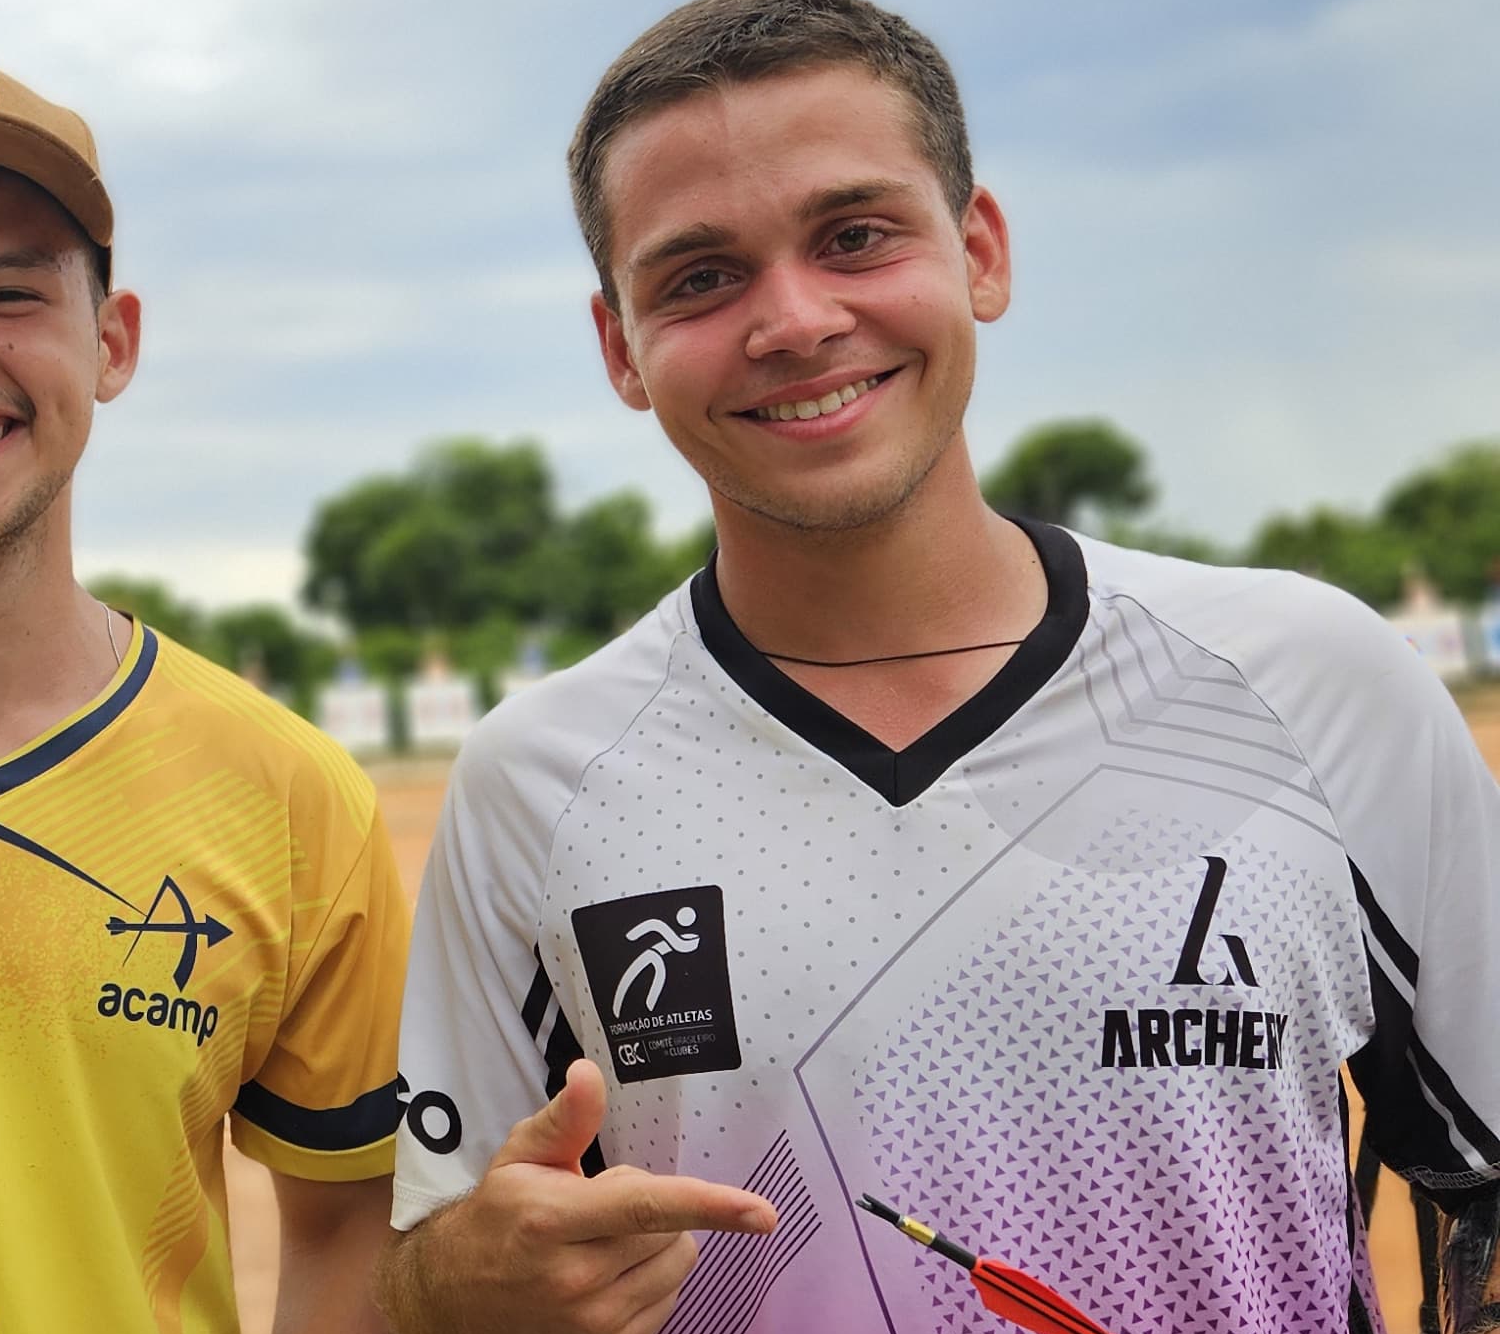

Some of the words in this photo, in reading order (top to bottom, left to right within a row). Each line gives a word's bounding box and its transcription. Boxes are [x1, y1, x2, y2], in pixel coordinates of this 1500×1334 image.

[97, 983, 219, 1047] acamp
[609, 1017, 651, 1036] FORMAÇÃO
[652, 1014, 665, 1027] DE
[666, 1009, 713, 1026] ATLETAS
[648, 1037, 673, 1050] COMITÊ
[669, 1044, 700, 1057] CLUBES
[1101, 1008, 1289, 1070] ARCHERY
[618, 1042, 646, 1066] CBC
